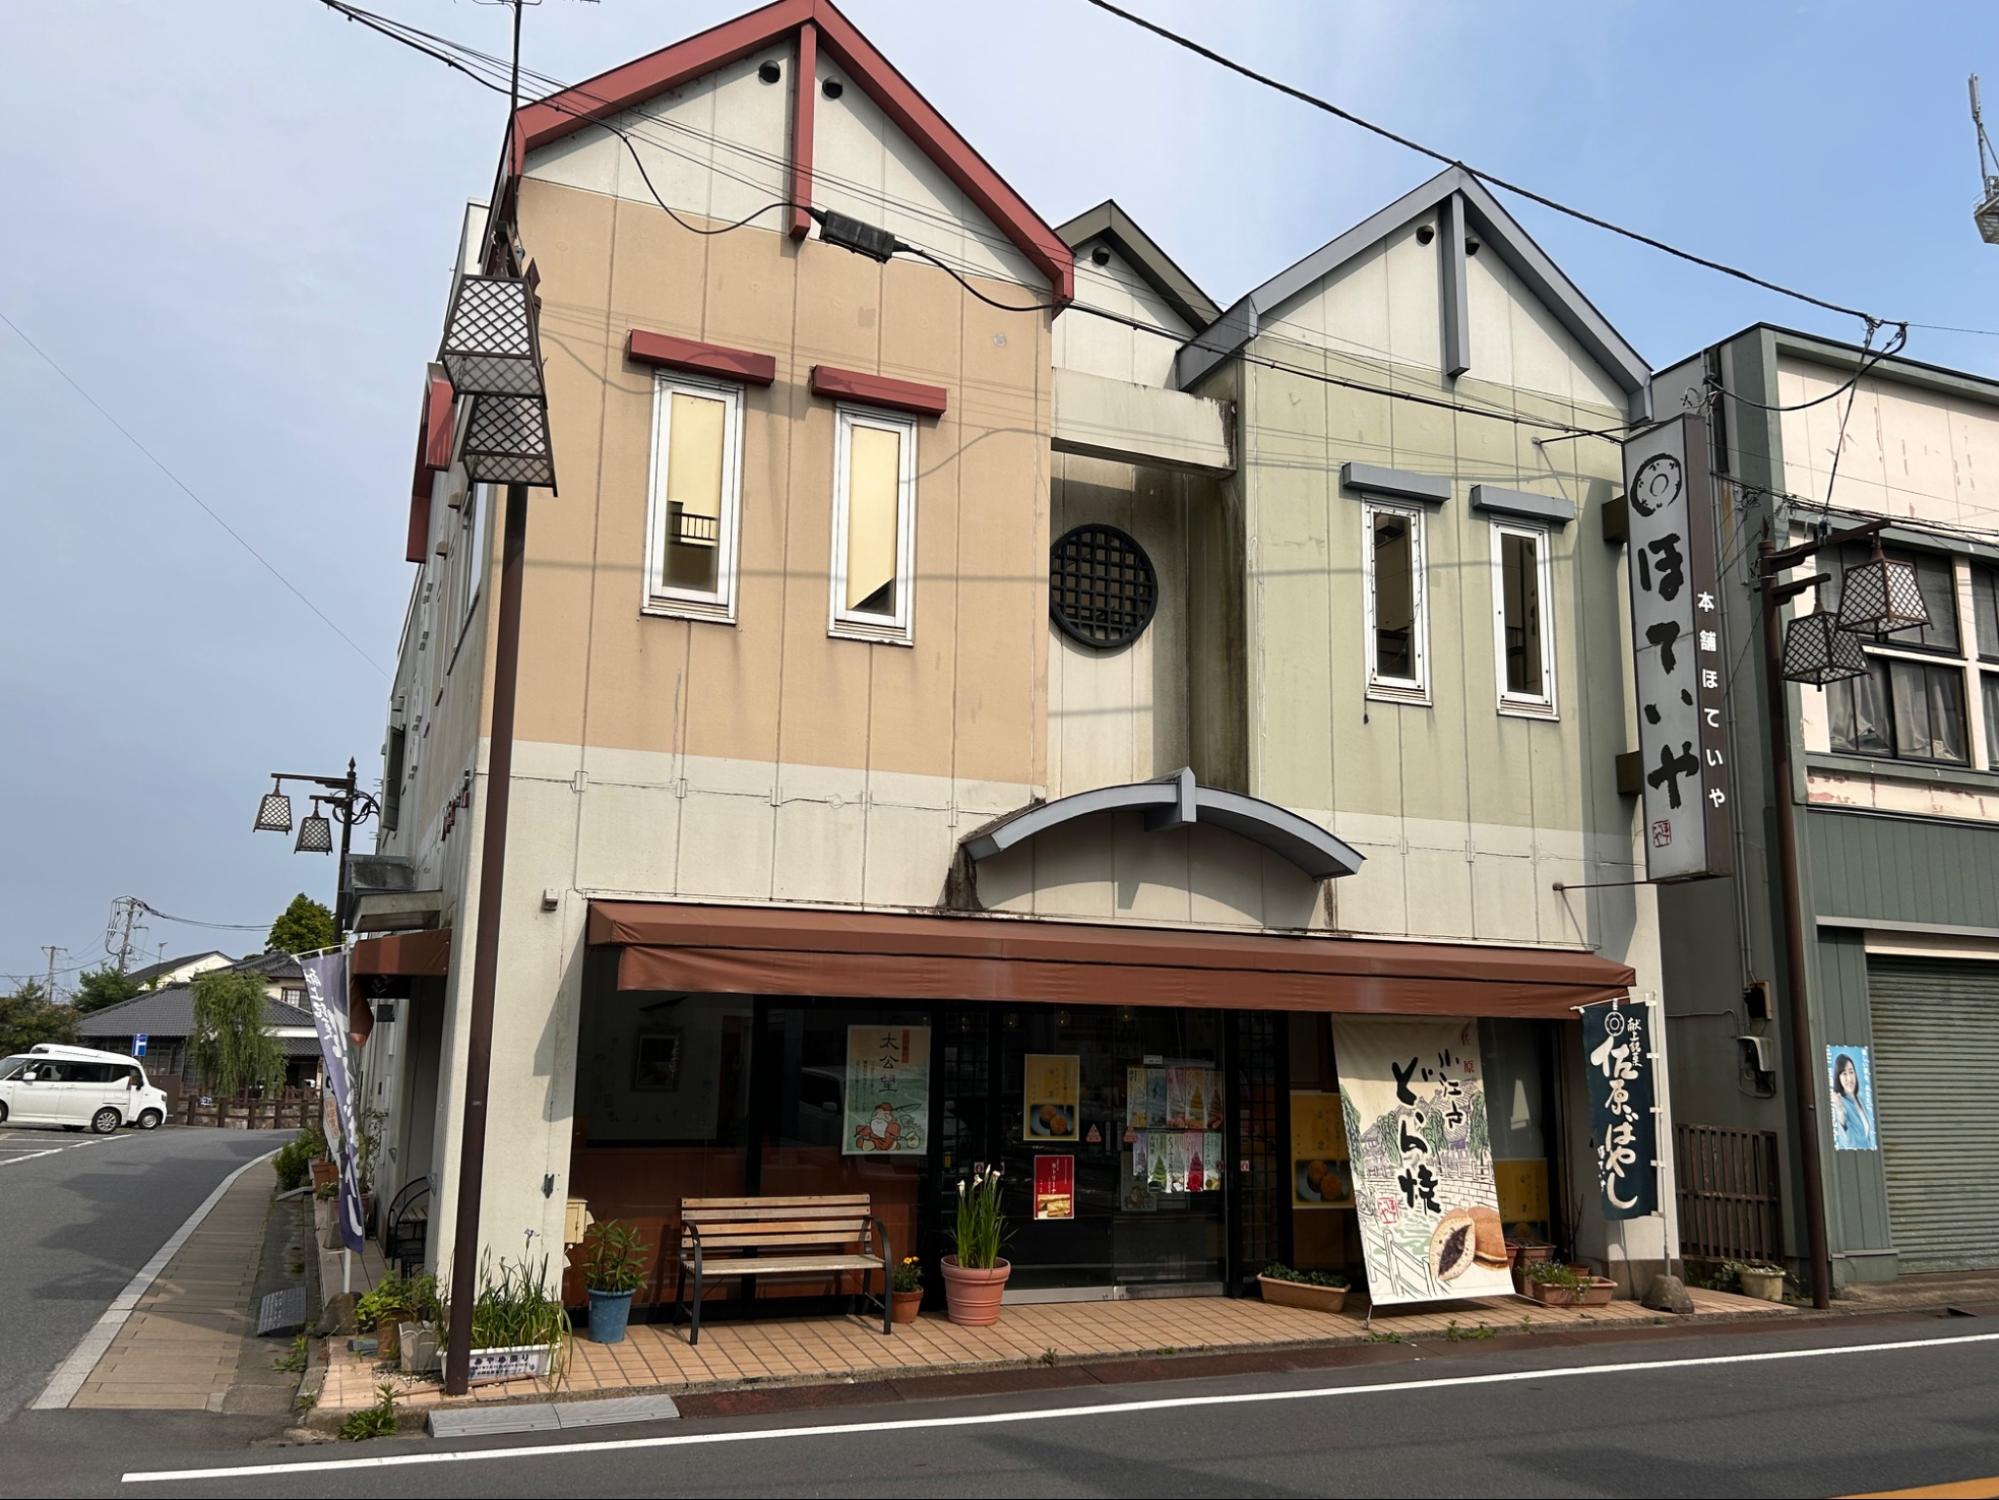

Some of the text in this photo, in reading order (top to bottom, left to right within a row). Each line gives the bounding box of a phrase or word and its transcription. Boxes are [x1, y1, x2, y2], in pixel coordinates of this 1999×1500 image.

[1637, 533, 1699, 809] ほていや
[1697, 591, 1726, 808] 本舗ほていや
[878, 1031, 900, 1092] 太公望
[1391, 1056, 1441, 1216] どら焼
[1590, 1036, 1639, 1210] 佐原ばやし
